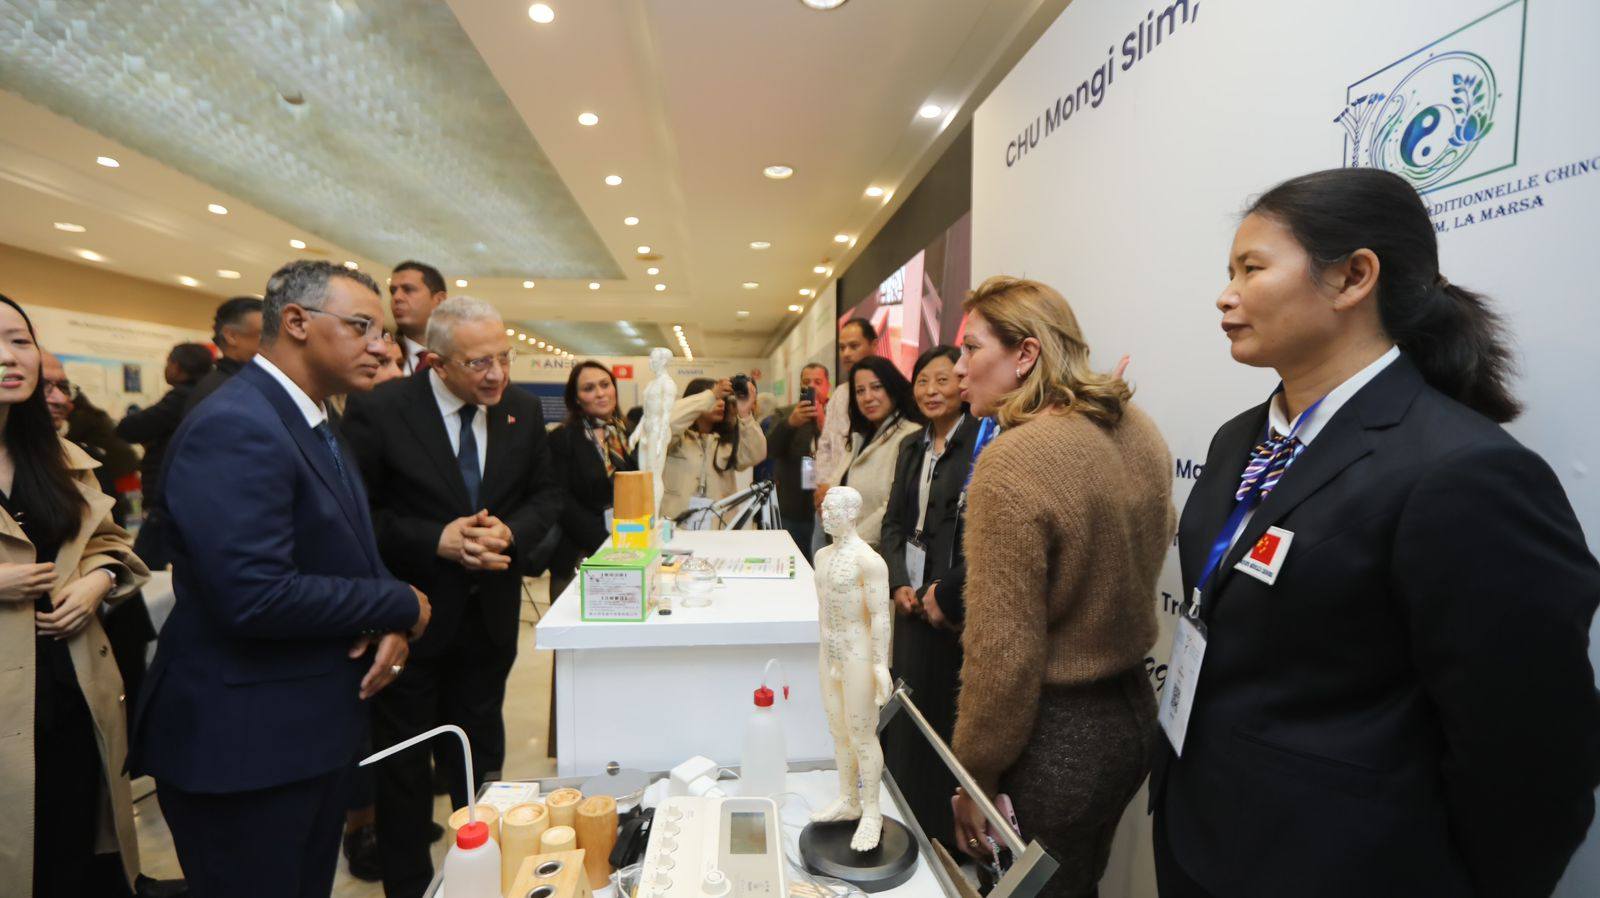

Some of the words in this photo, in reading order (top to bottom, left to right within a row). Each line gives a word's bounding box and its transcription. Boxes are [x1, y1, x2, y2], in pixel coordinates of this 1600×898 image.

[1005, 115, 1041, 168] CHU
[1044, 45, 1115, 137] Mongi
[1121, 0, 1200, 72] Slim,
[1454, 213, 1475, 229] LA
[1480, 195, 1545, 223] MARSA
